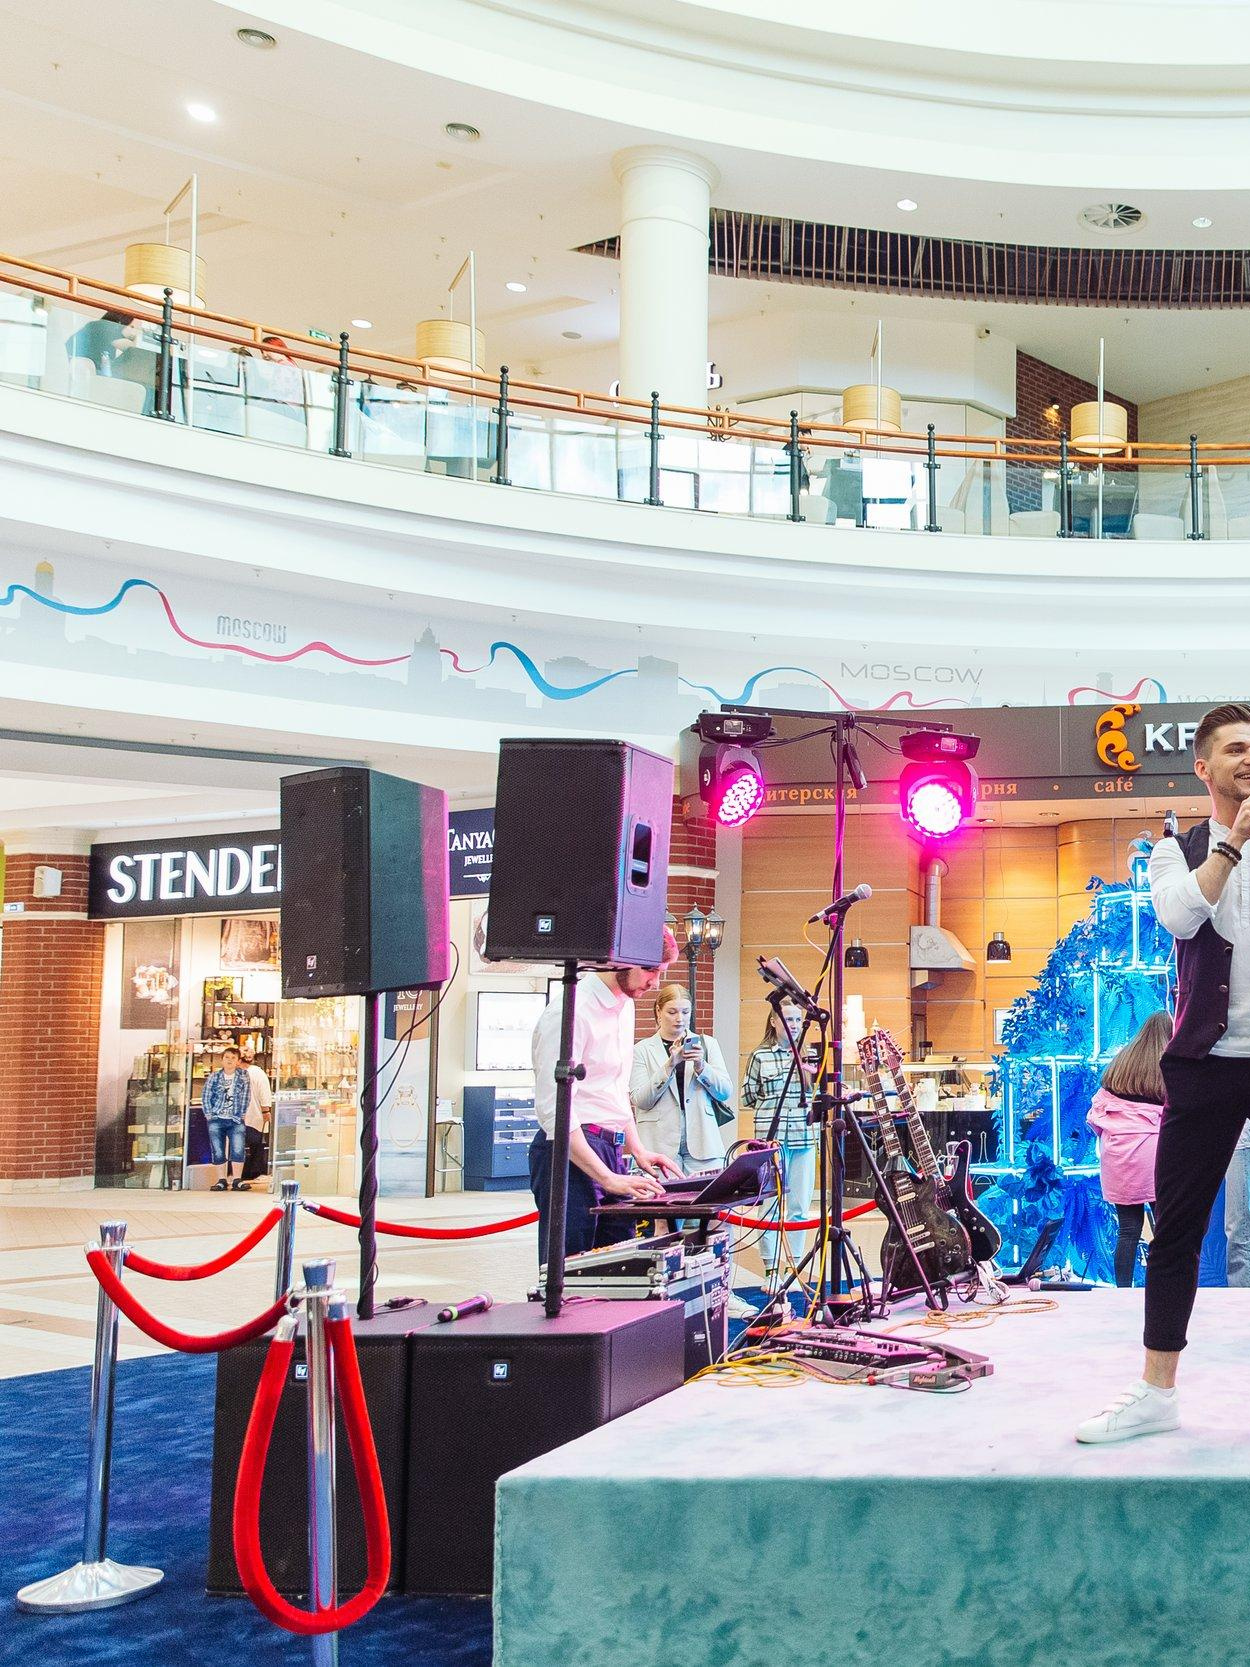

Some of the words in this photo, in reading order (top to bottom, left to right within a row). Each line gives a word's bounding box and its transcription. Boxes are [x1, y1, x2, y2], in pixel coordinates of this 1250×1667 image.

[840, 662, 983, 685] MOSCOW
[1094, 776, 1133, 793] café
[446, 828, 495, 852] TANYA
[107, 843, 282, 904] STENDE
